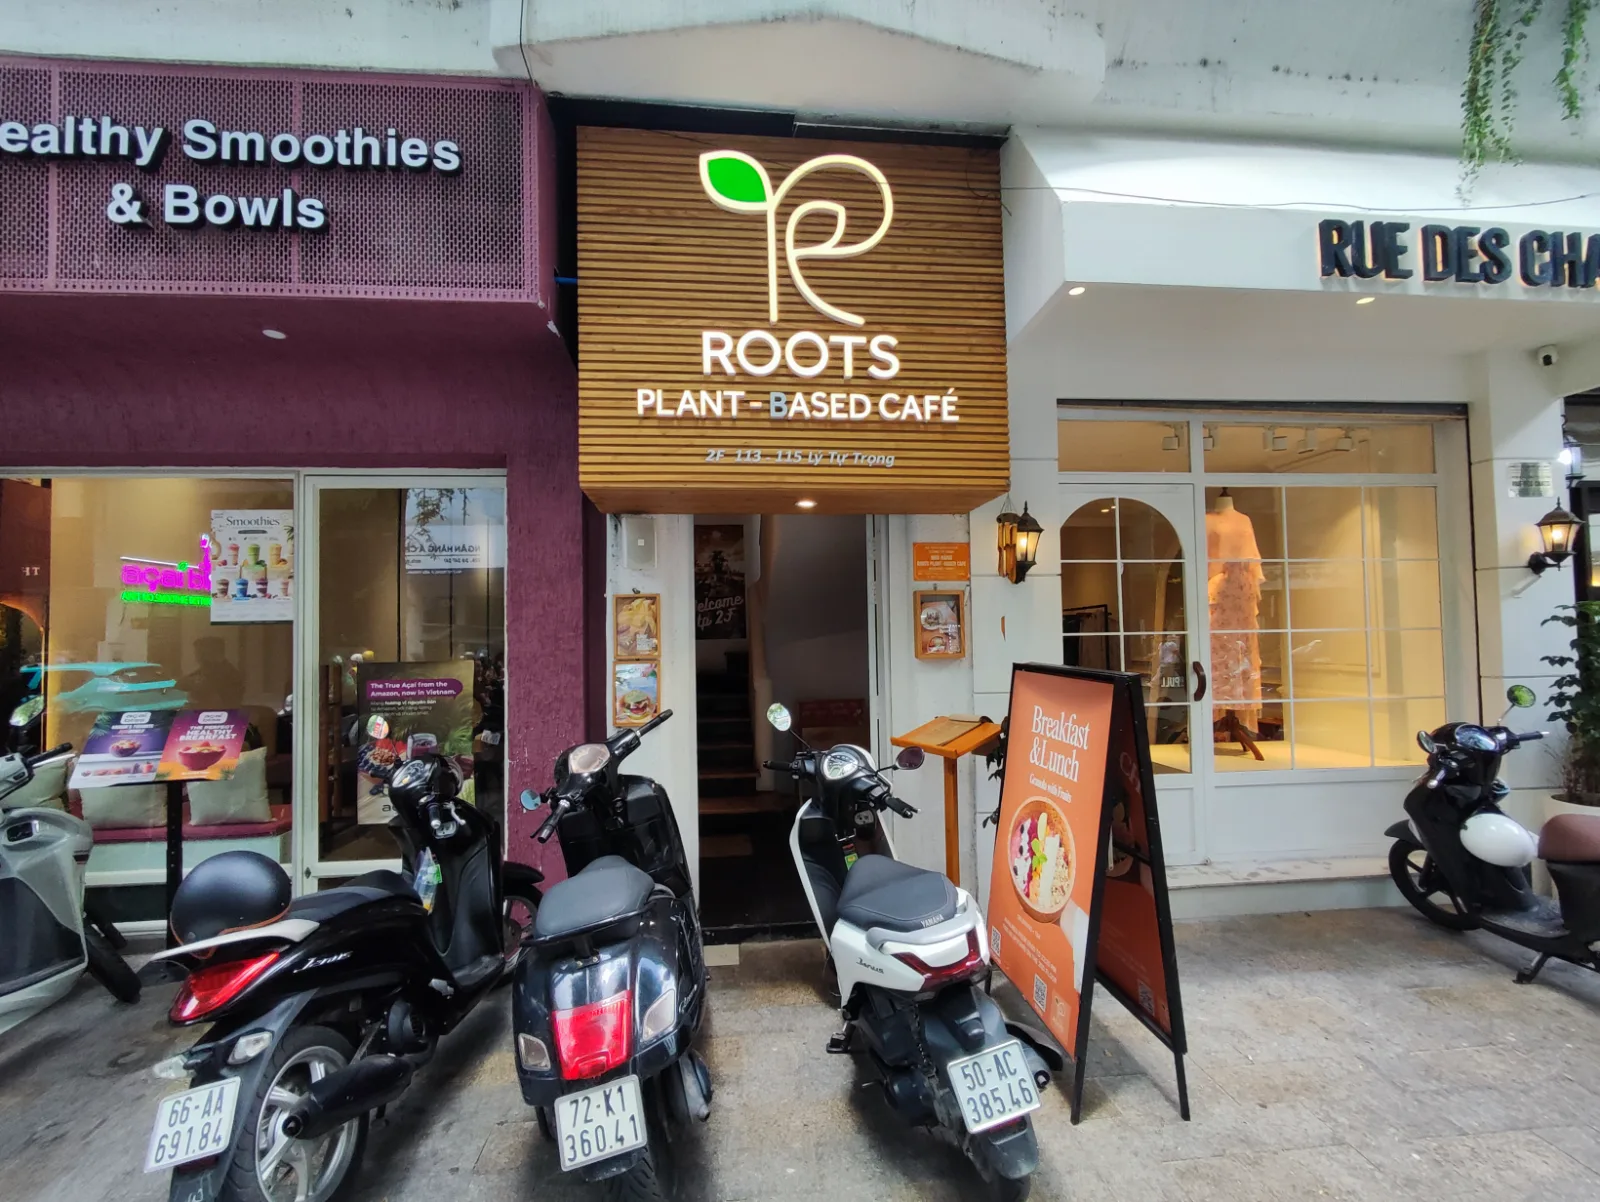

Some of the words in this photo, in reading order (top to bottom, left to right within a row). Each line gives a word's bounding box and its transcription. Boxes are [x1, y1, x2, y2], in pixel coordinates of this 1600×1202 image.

[182, 118, 461, 172] Smoothies
[106, 182, 145, 224] &
[164, 184, 326, 229] Bowls
[1317, 219, 1413, 280] RUE
[1419, 223, 1513, 285] DES
[702, 329, 901, 380] ROOTS
[878, 387, 960, 423] CAFÉ
[705, 449, 726, 463] 2F
[734, 449, 763, 464] 113
[775, 450, 802, 464] 115
[807, 450, 823, 466] Lý
[827, 451, 849, 467] Tự
[852, 451, 896, 468] Trọng
[225, 515, 281, 527] Smoothies
[697, 595, 744, 612] elcome
[1031, 705, 1091, 750] Breakfast
[920, 914, 945, 929] YAMAHA
[960, 1050, 1017, 1091] 50-AC
[168, 1086, 225, 1128] 66-AA
[569, 1085, 626, 1128] 72-K1
[966, 1077, 1034, 1124] 385.46
[154, 1117, 223, 1164] 691.84
[565, 1113, 639, 1162] 360.41
